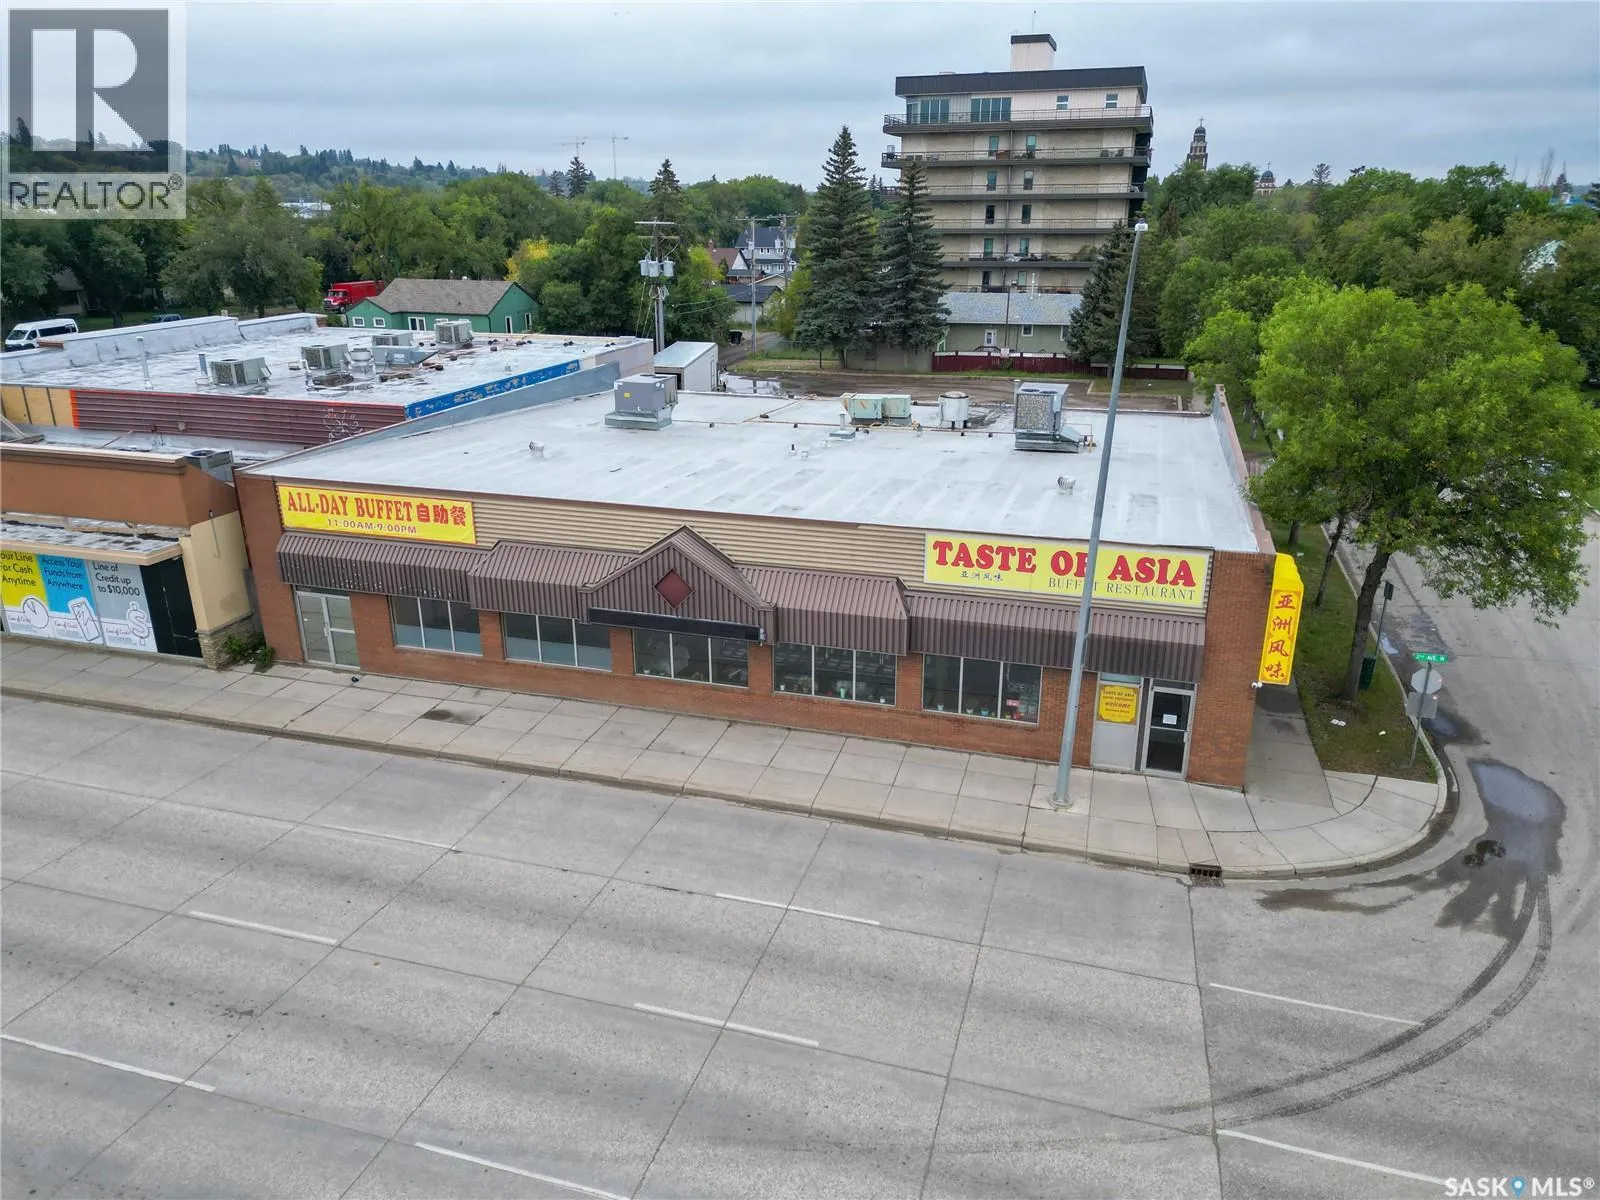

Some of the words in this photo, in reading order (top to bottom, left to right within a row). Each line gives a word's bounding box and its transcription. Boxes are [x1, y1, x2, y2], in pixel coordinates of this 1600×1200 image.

[287, 490, 349, 517] ALL-DAY
[355, 497, 412, 522] BUFFET
[416, 503, 467, 527] 自助餐
[327, 518, 417, 535] 11:00AM-9:00PM
[0, 552, 13, 561] our
[15, 552, 33, 562] Line
[42, 556, 65, 567] Access
[67, 559, 82, 568] Your
[13, 563, 33, 574] Cash
[93, 561, 109, 571] Line
[111, 563, 118, 571] of
[932, 540, 1037, 574] TASTE
[1107, 555, 1196, 588] ASIA
[44, 567, 65, 577] Funds
[66, 569, 84, 580] from
[95, 572, 119, 583] Credit
[121, 577, 131, 586] up
[960, 570, 1004, 583] 亚洲风味
[2, 575, 36, 587] Anytime
[47, 578, 84, 590] Anywhere
[98, 585, 106, 593] to
[107, 584, 140, 596] $10,000
[1048, 577, 1100, 595] BUFFT
[1106, 582, 1196, 601] RESTAURANT
[1263, 594, 1296, 679] 亚洲风味
